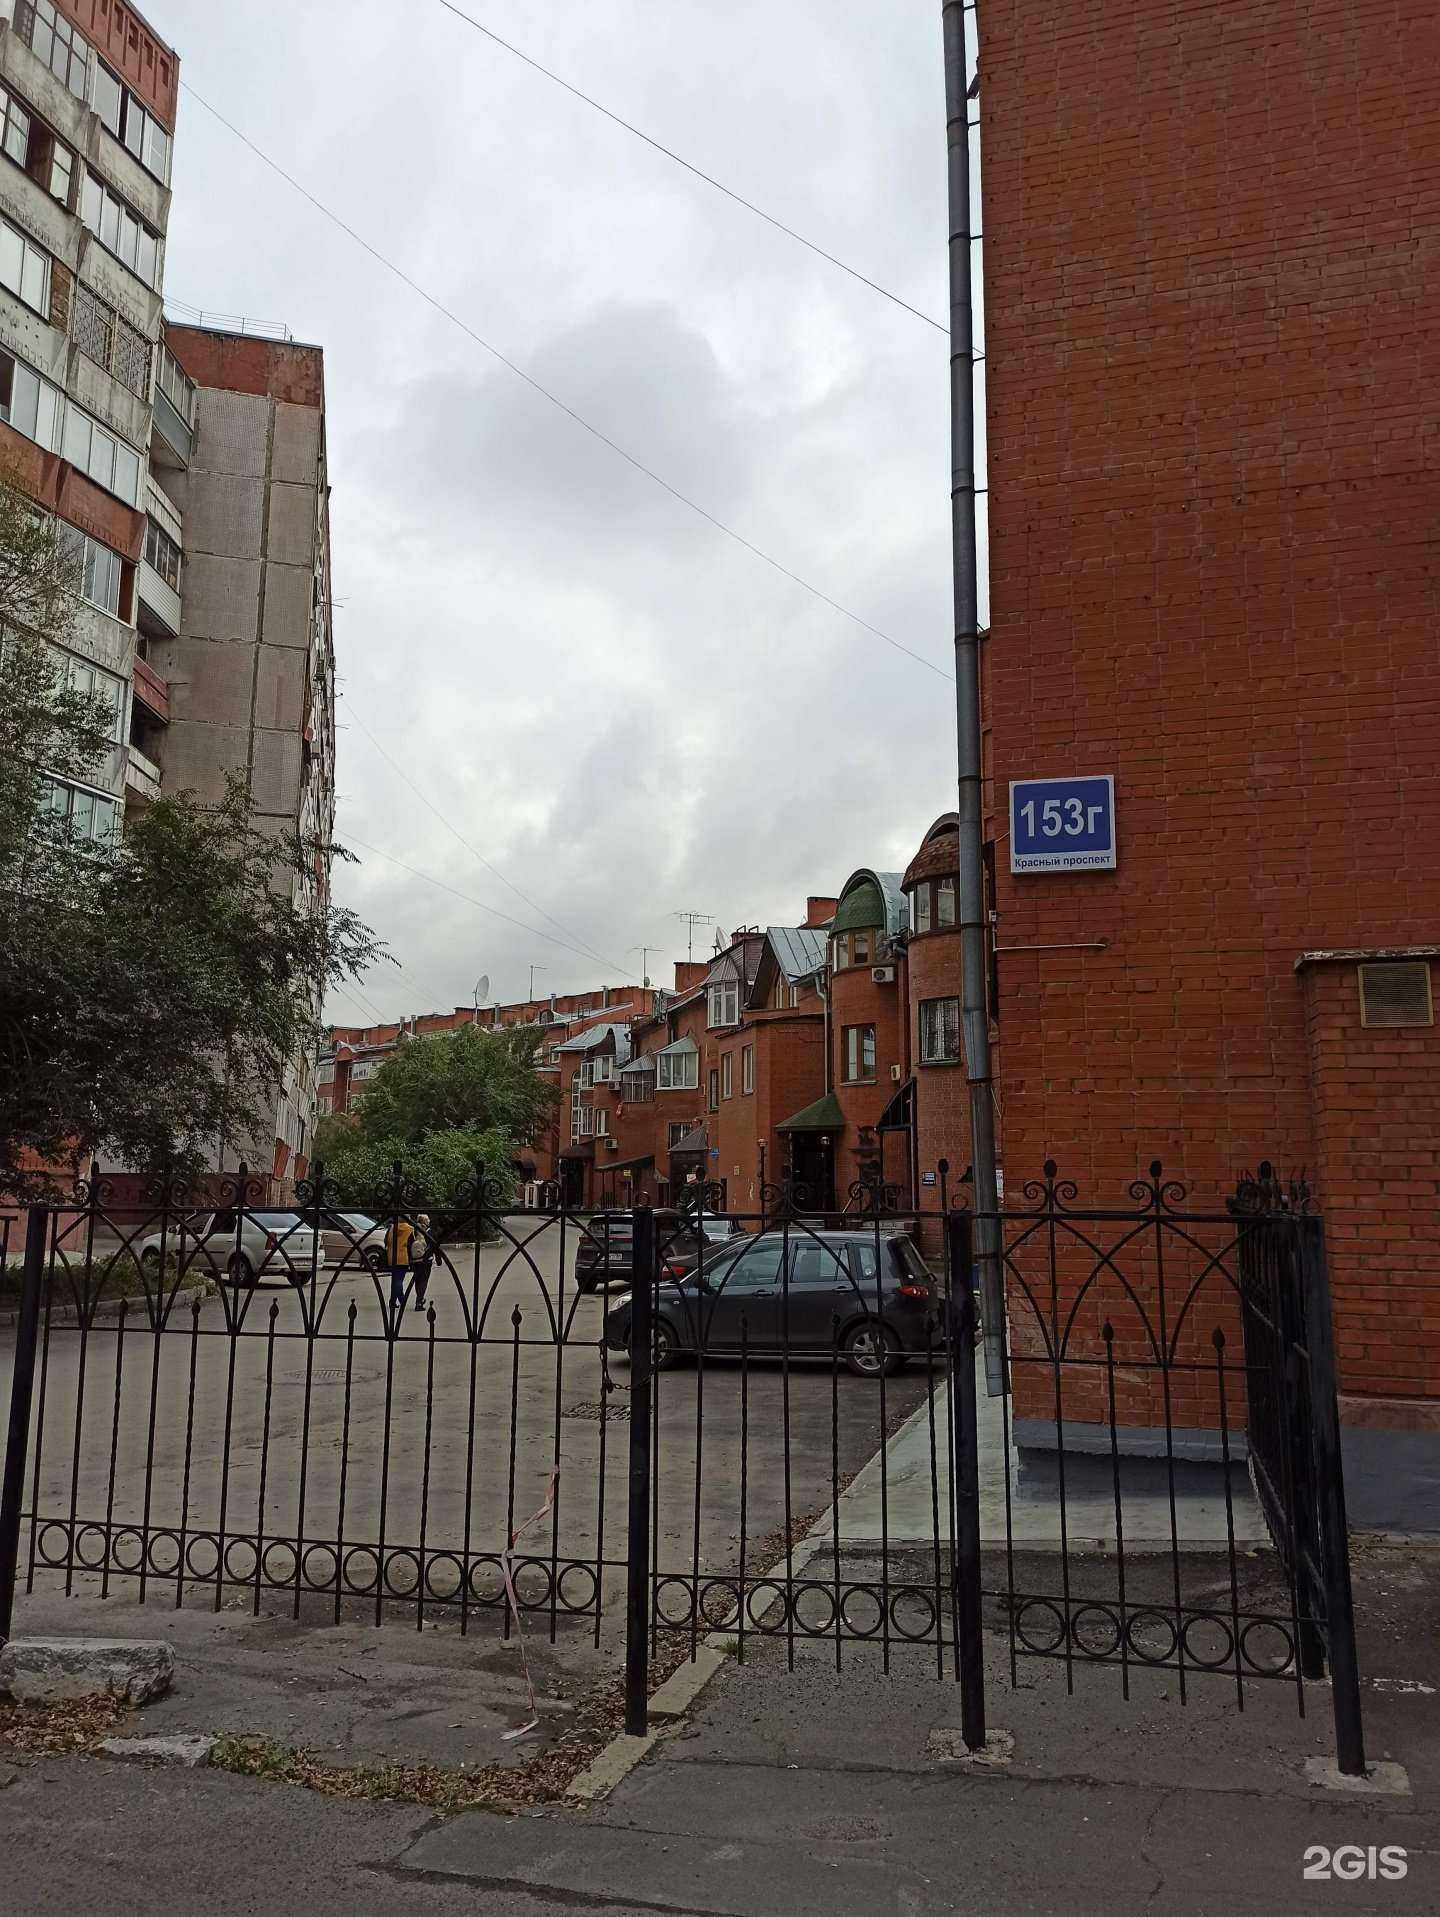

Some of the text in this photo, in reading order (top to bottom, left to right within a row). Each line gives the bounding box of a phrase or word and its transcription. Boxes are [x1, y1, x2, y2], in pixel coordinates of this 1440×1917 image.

[1020, 797, 1103, 837] 153г
[1015, 856, 1110, 868] Красный проспект
